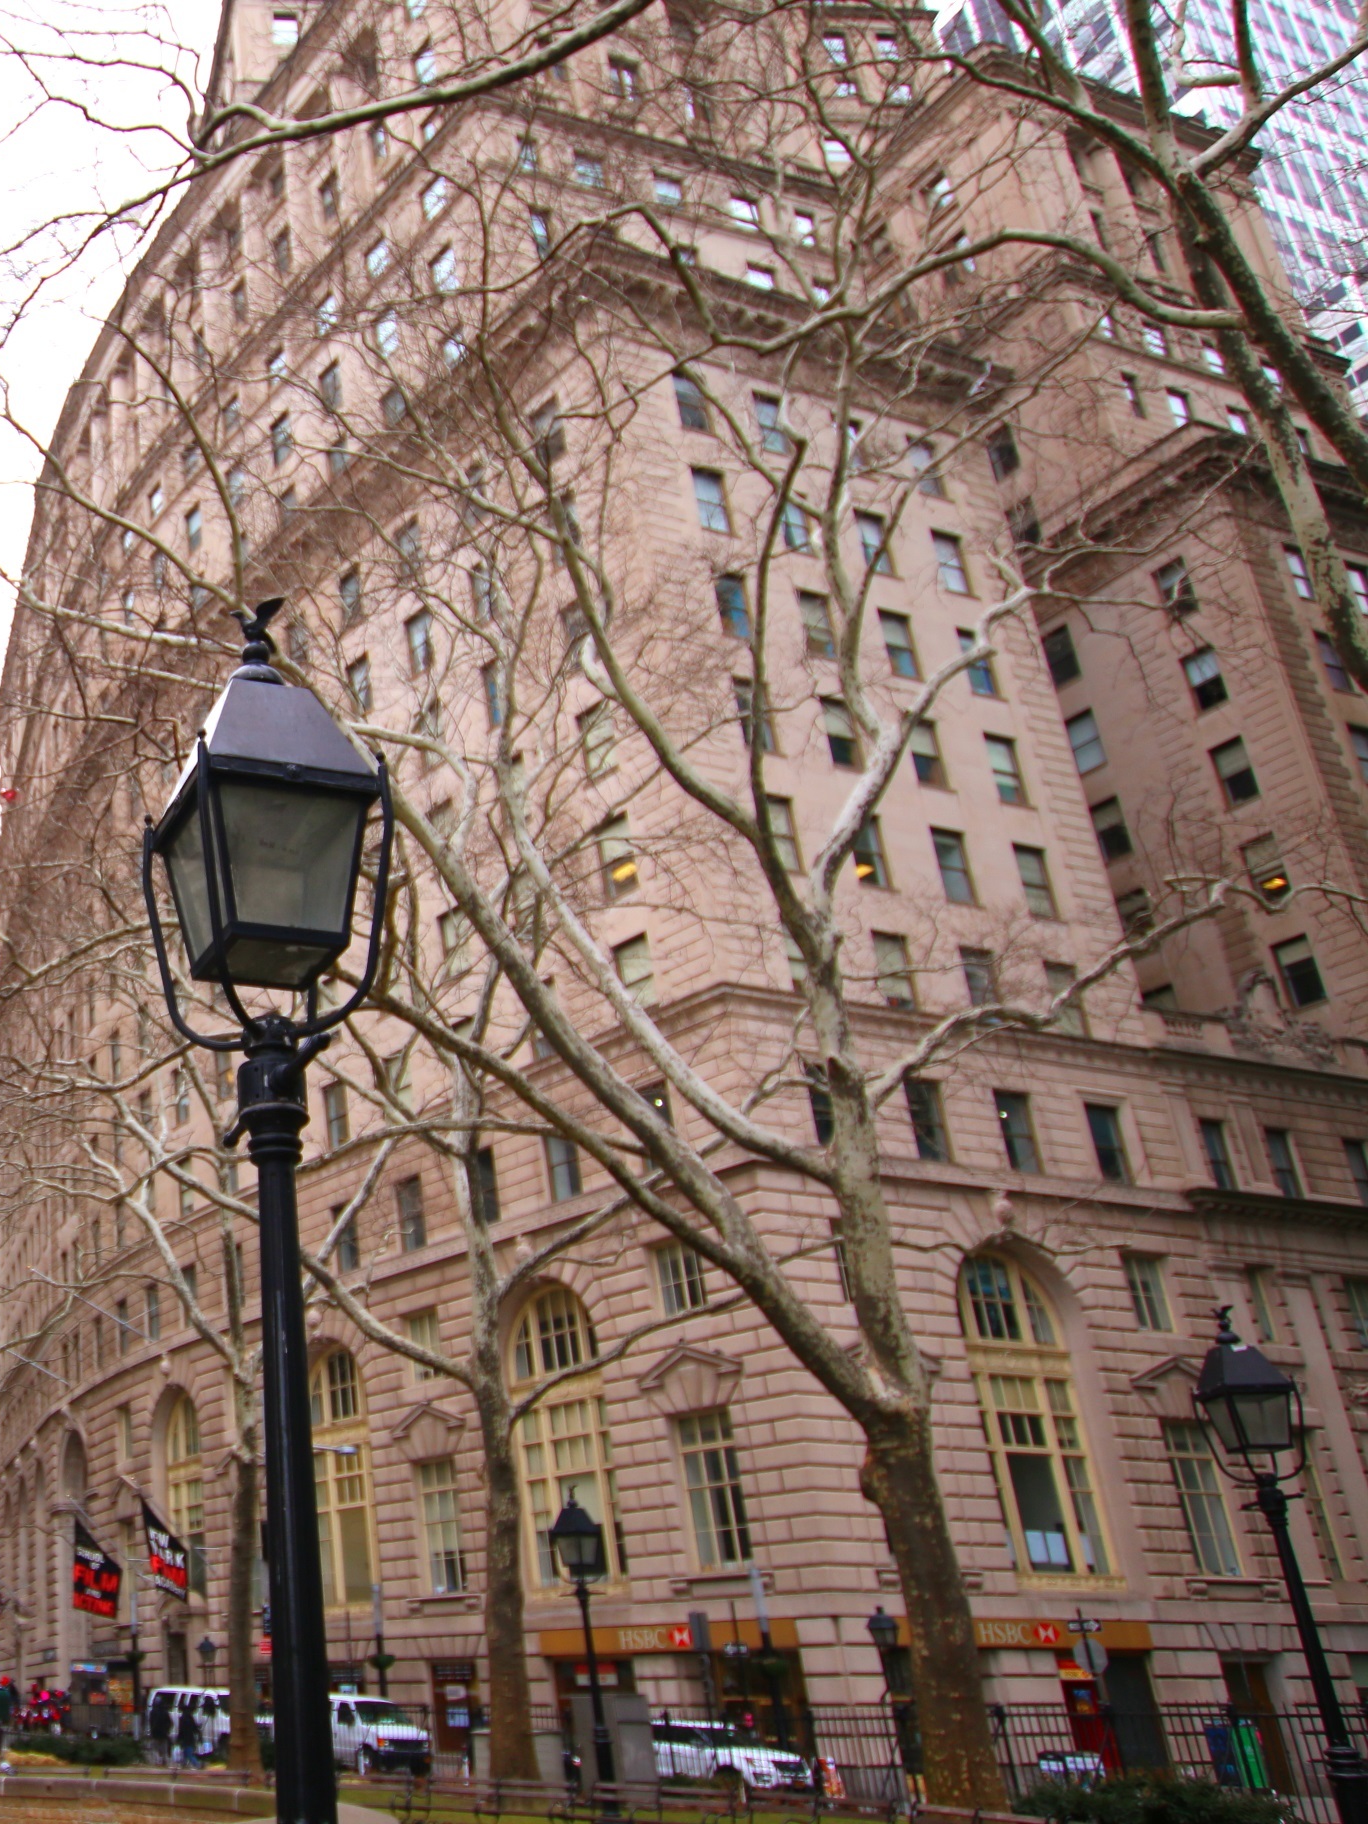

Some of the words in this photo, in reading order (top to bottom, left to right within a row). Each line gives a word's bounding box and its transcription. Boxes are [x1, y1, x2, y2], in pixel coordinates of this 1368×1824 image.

[73, 1564, 120, 1594] FILM
[618, 1627, 666, 1650] HSBC
[977, 1622, 1032, 1645] HSBC
